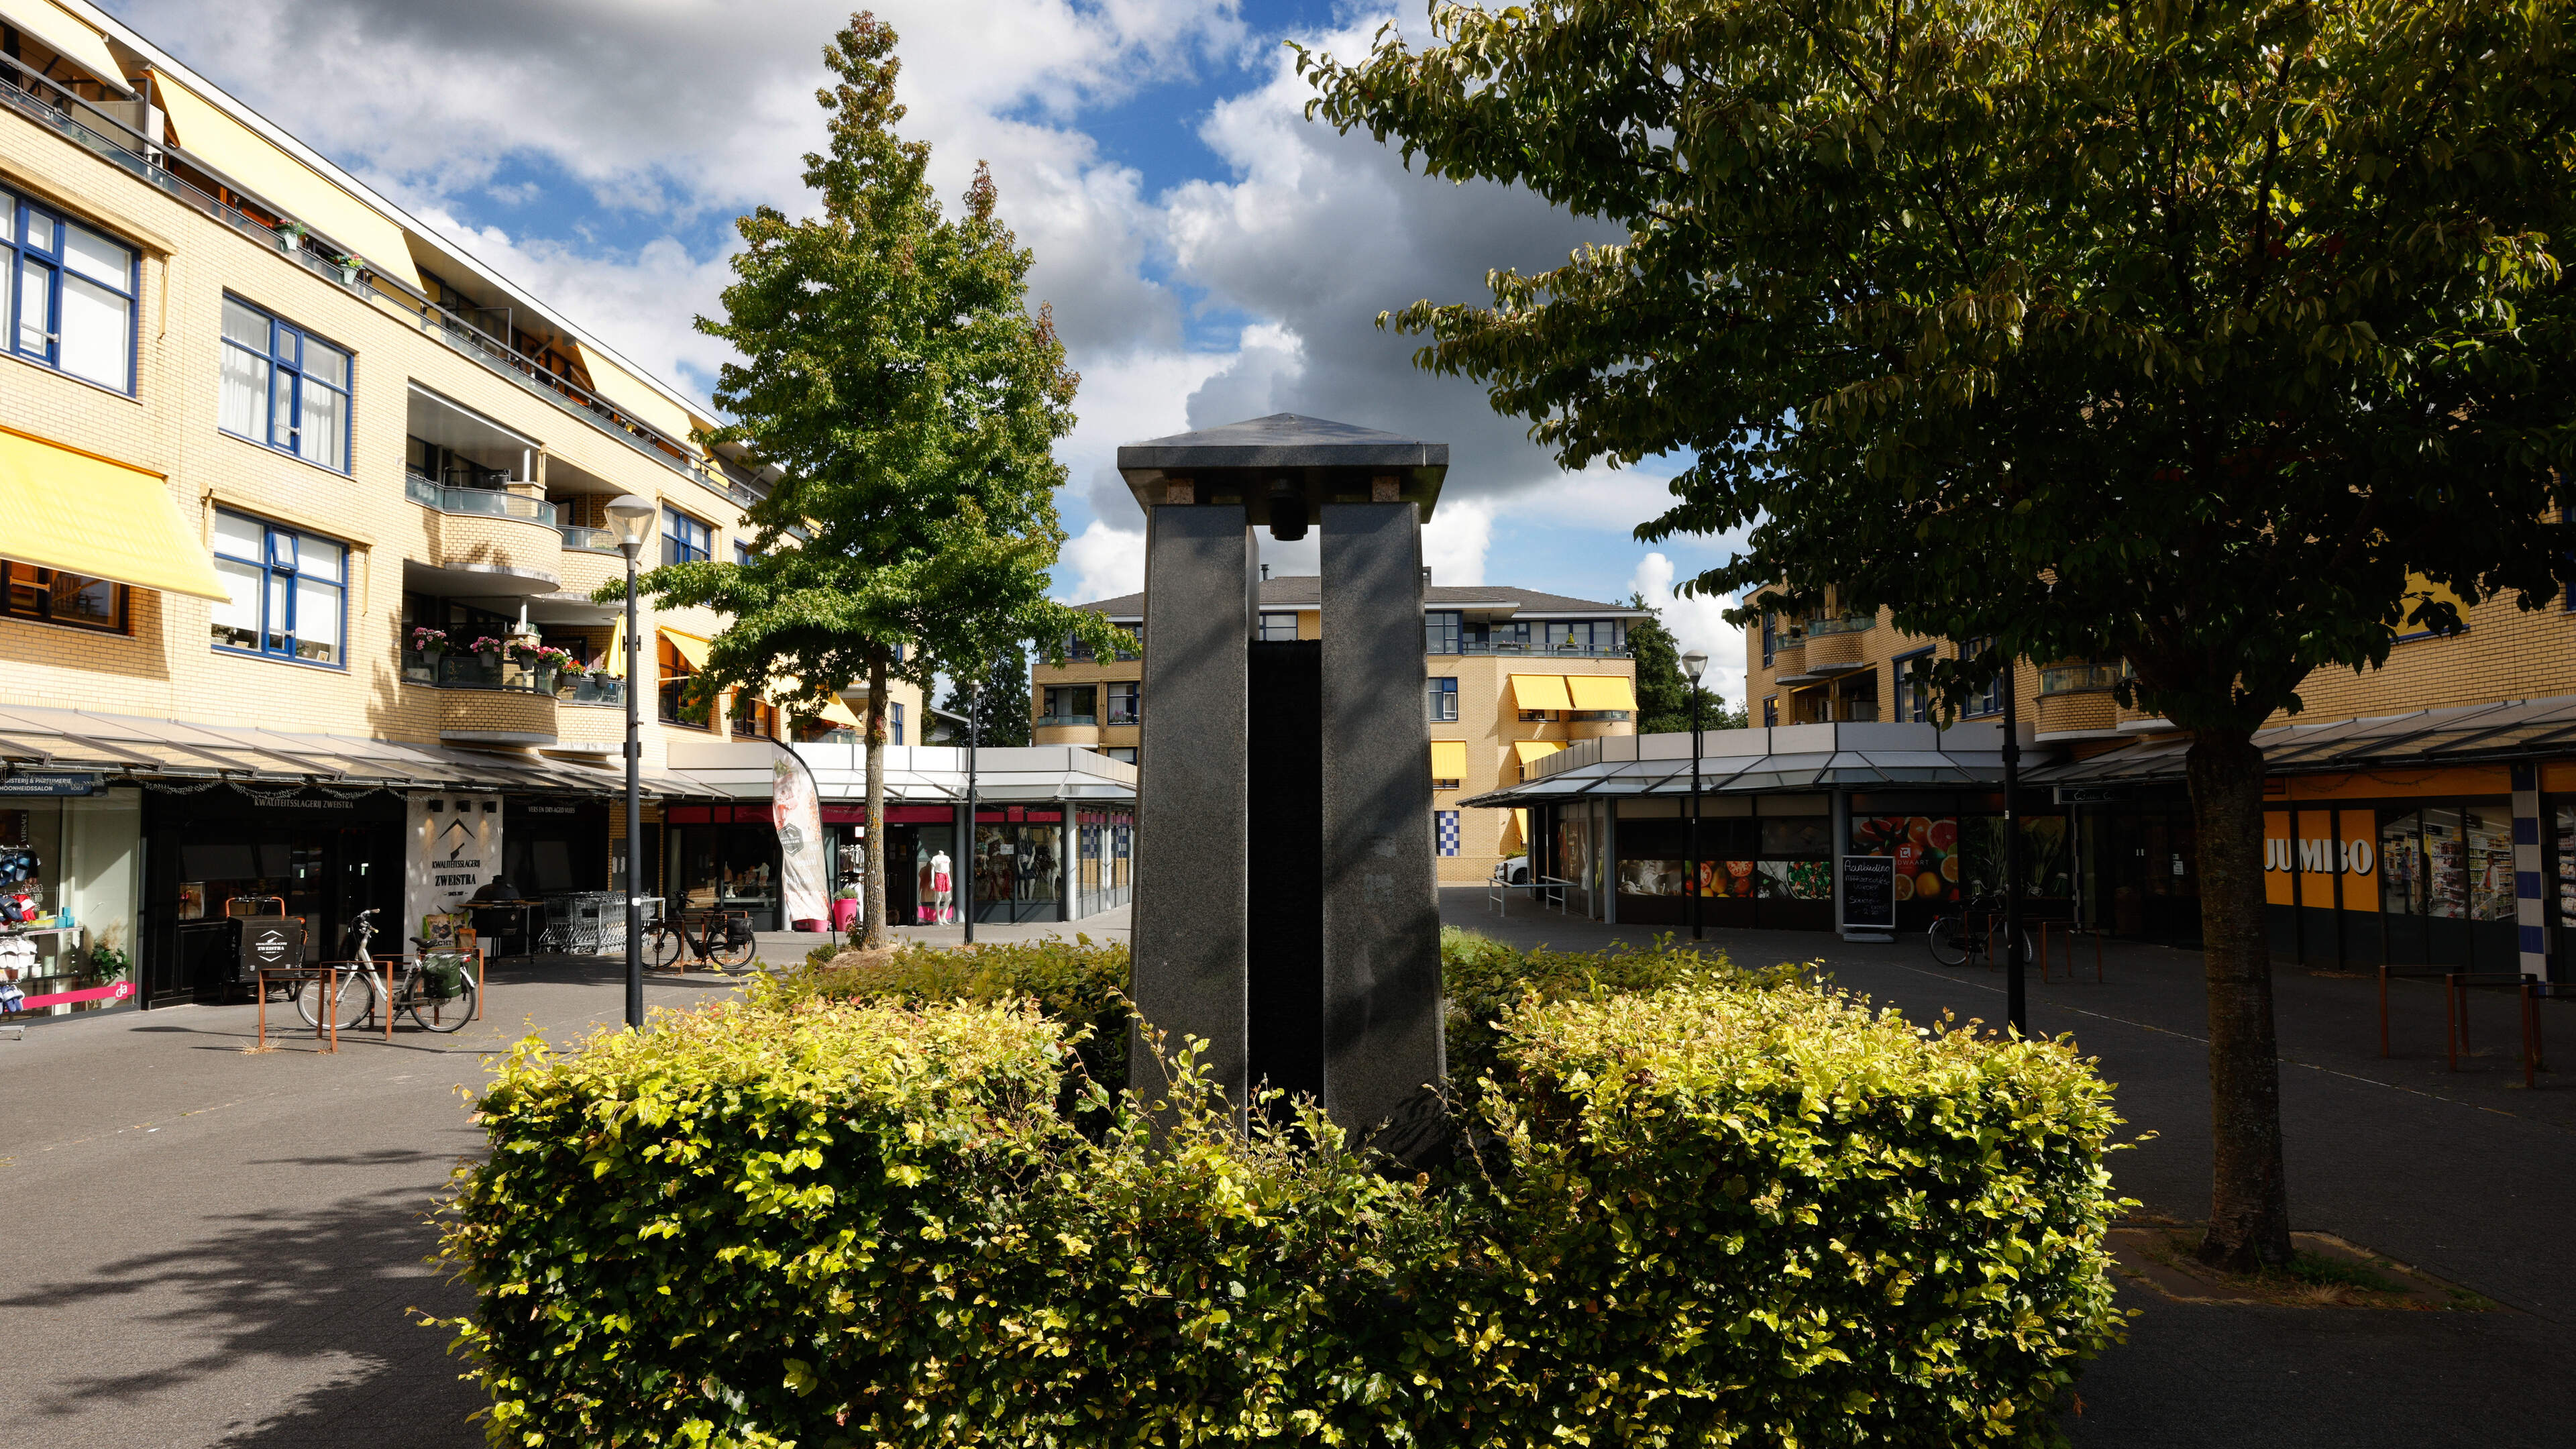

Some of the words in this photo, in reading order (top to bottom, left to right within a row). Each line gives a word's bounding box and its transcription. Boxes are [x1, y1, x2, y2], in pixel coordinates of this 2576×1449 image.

[254, 799, 321, 808] KWALITEITSSLAGERIJ
[323, 800, 354, 808] ZWEISTRA
[2264, 838, 2374, 876] JUMBO
[432, 859, 480, 869] KWALITEITSSLAGERIJ
[435, 873, 476, 886] ZWEISTRA
